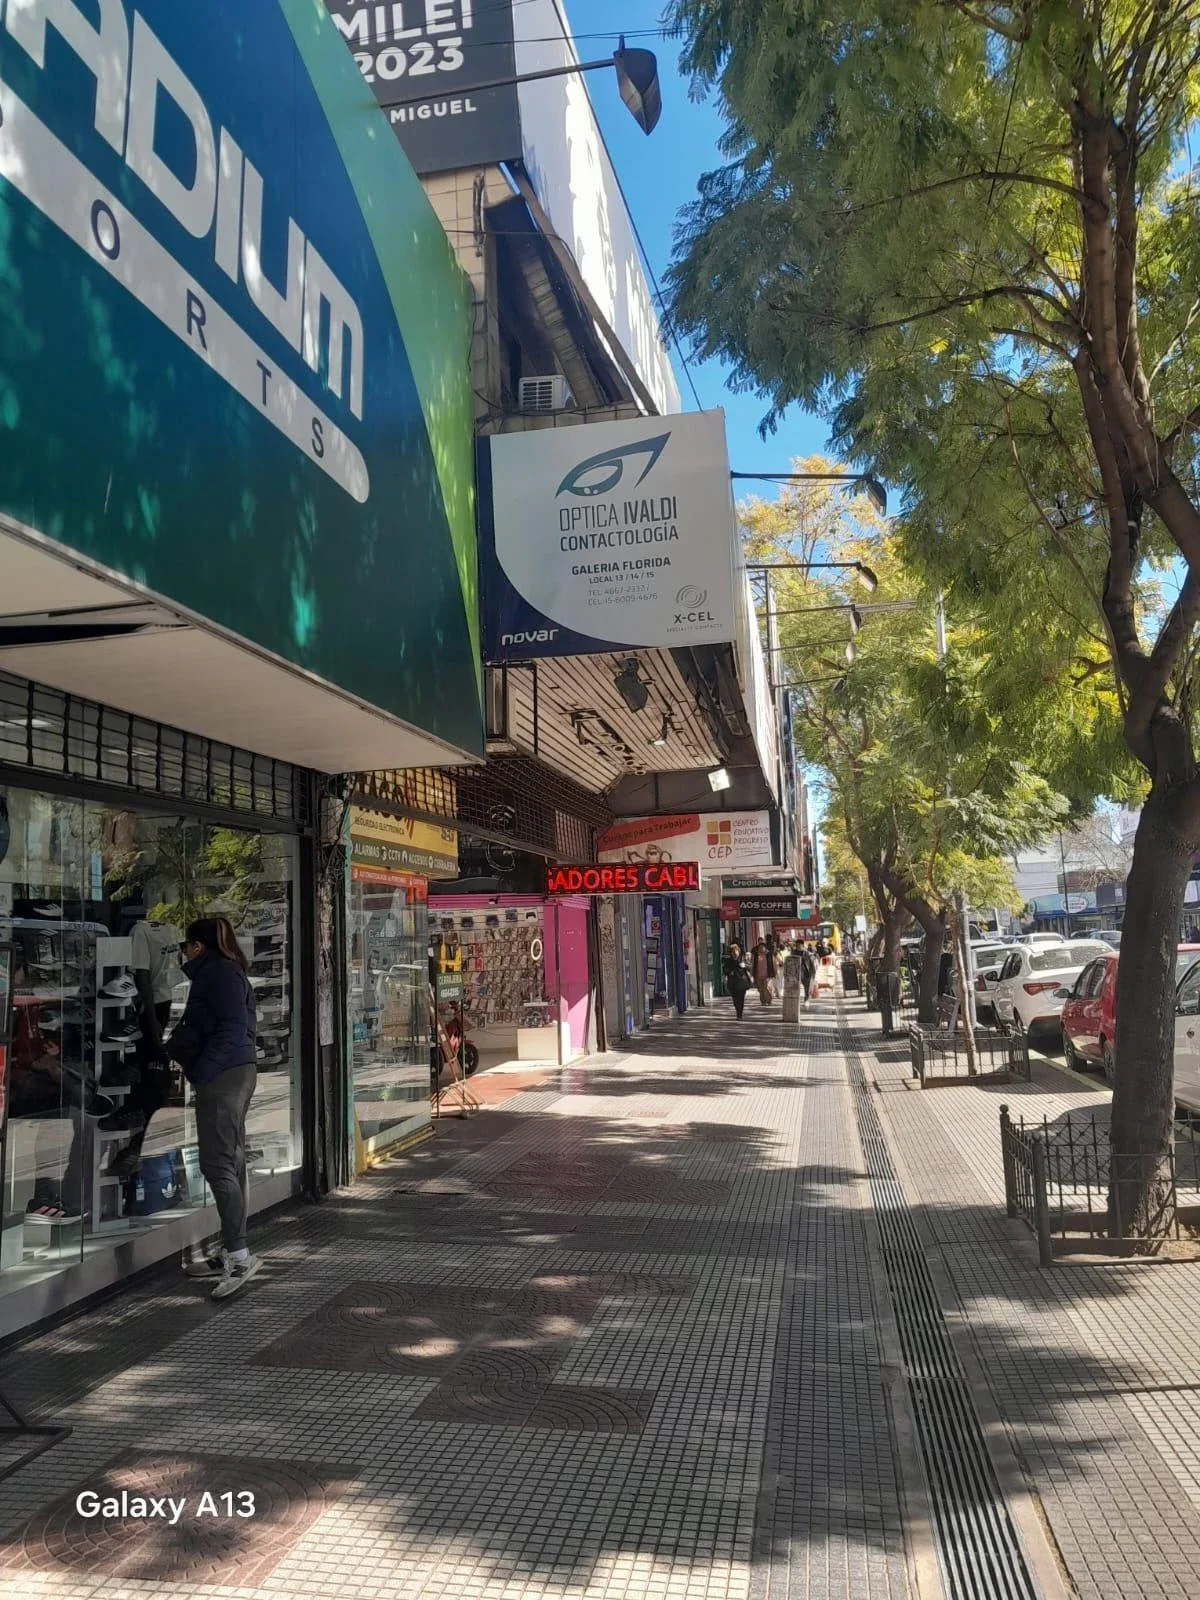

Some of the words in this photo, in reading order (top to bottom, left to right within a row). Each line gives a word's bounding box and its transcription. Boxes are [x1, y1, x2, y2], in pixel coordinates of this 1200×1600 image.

[330, 0, 473, 46] MILEI
[352, 36, 464, 83] 2023
[390, 98, 477, 124] MIGUEL
[559, 503, 619, 532] OPTICA
[623, 496, 677, 525] IVALDI
[560, 522, 679, 551] CONTACTOLOGÍA
[571, 561, 620, 576] GALERIA
[622, 556, 672, 573] FLORIDA
[589, 575, 613, 584] LOCAL
[615, 574, 624, 582] 13
[630, 572, 639, 580] 14
[673, 611, 715, 624] X-CEL
[501, 628, 559, 646] novar
[654, 816, 692, 833] Trabajar
[733, 818, 759, 828] CENTRO
[354, 844, 379, 858] ALARMAS
[708, 845, 733, 860] CEP
[740, 901, 760, 909] AOS
[761, 901, 792, 909] COFFEE
